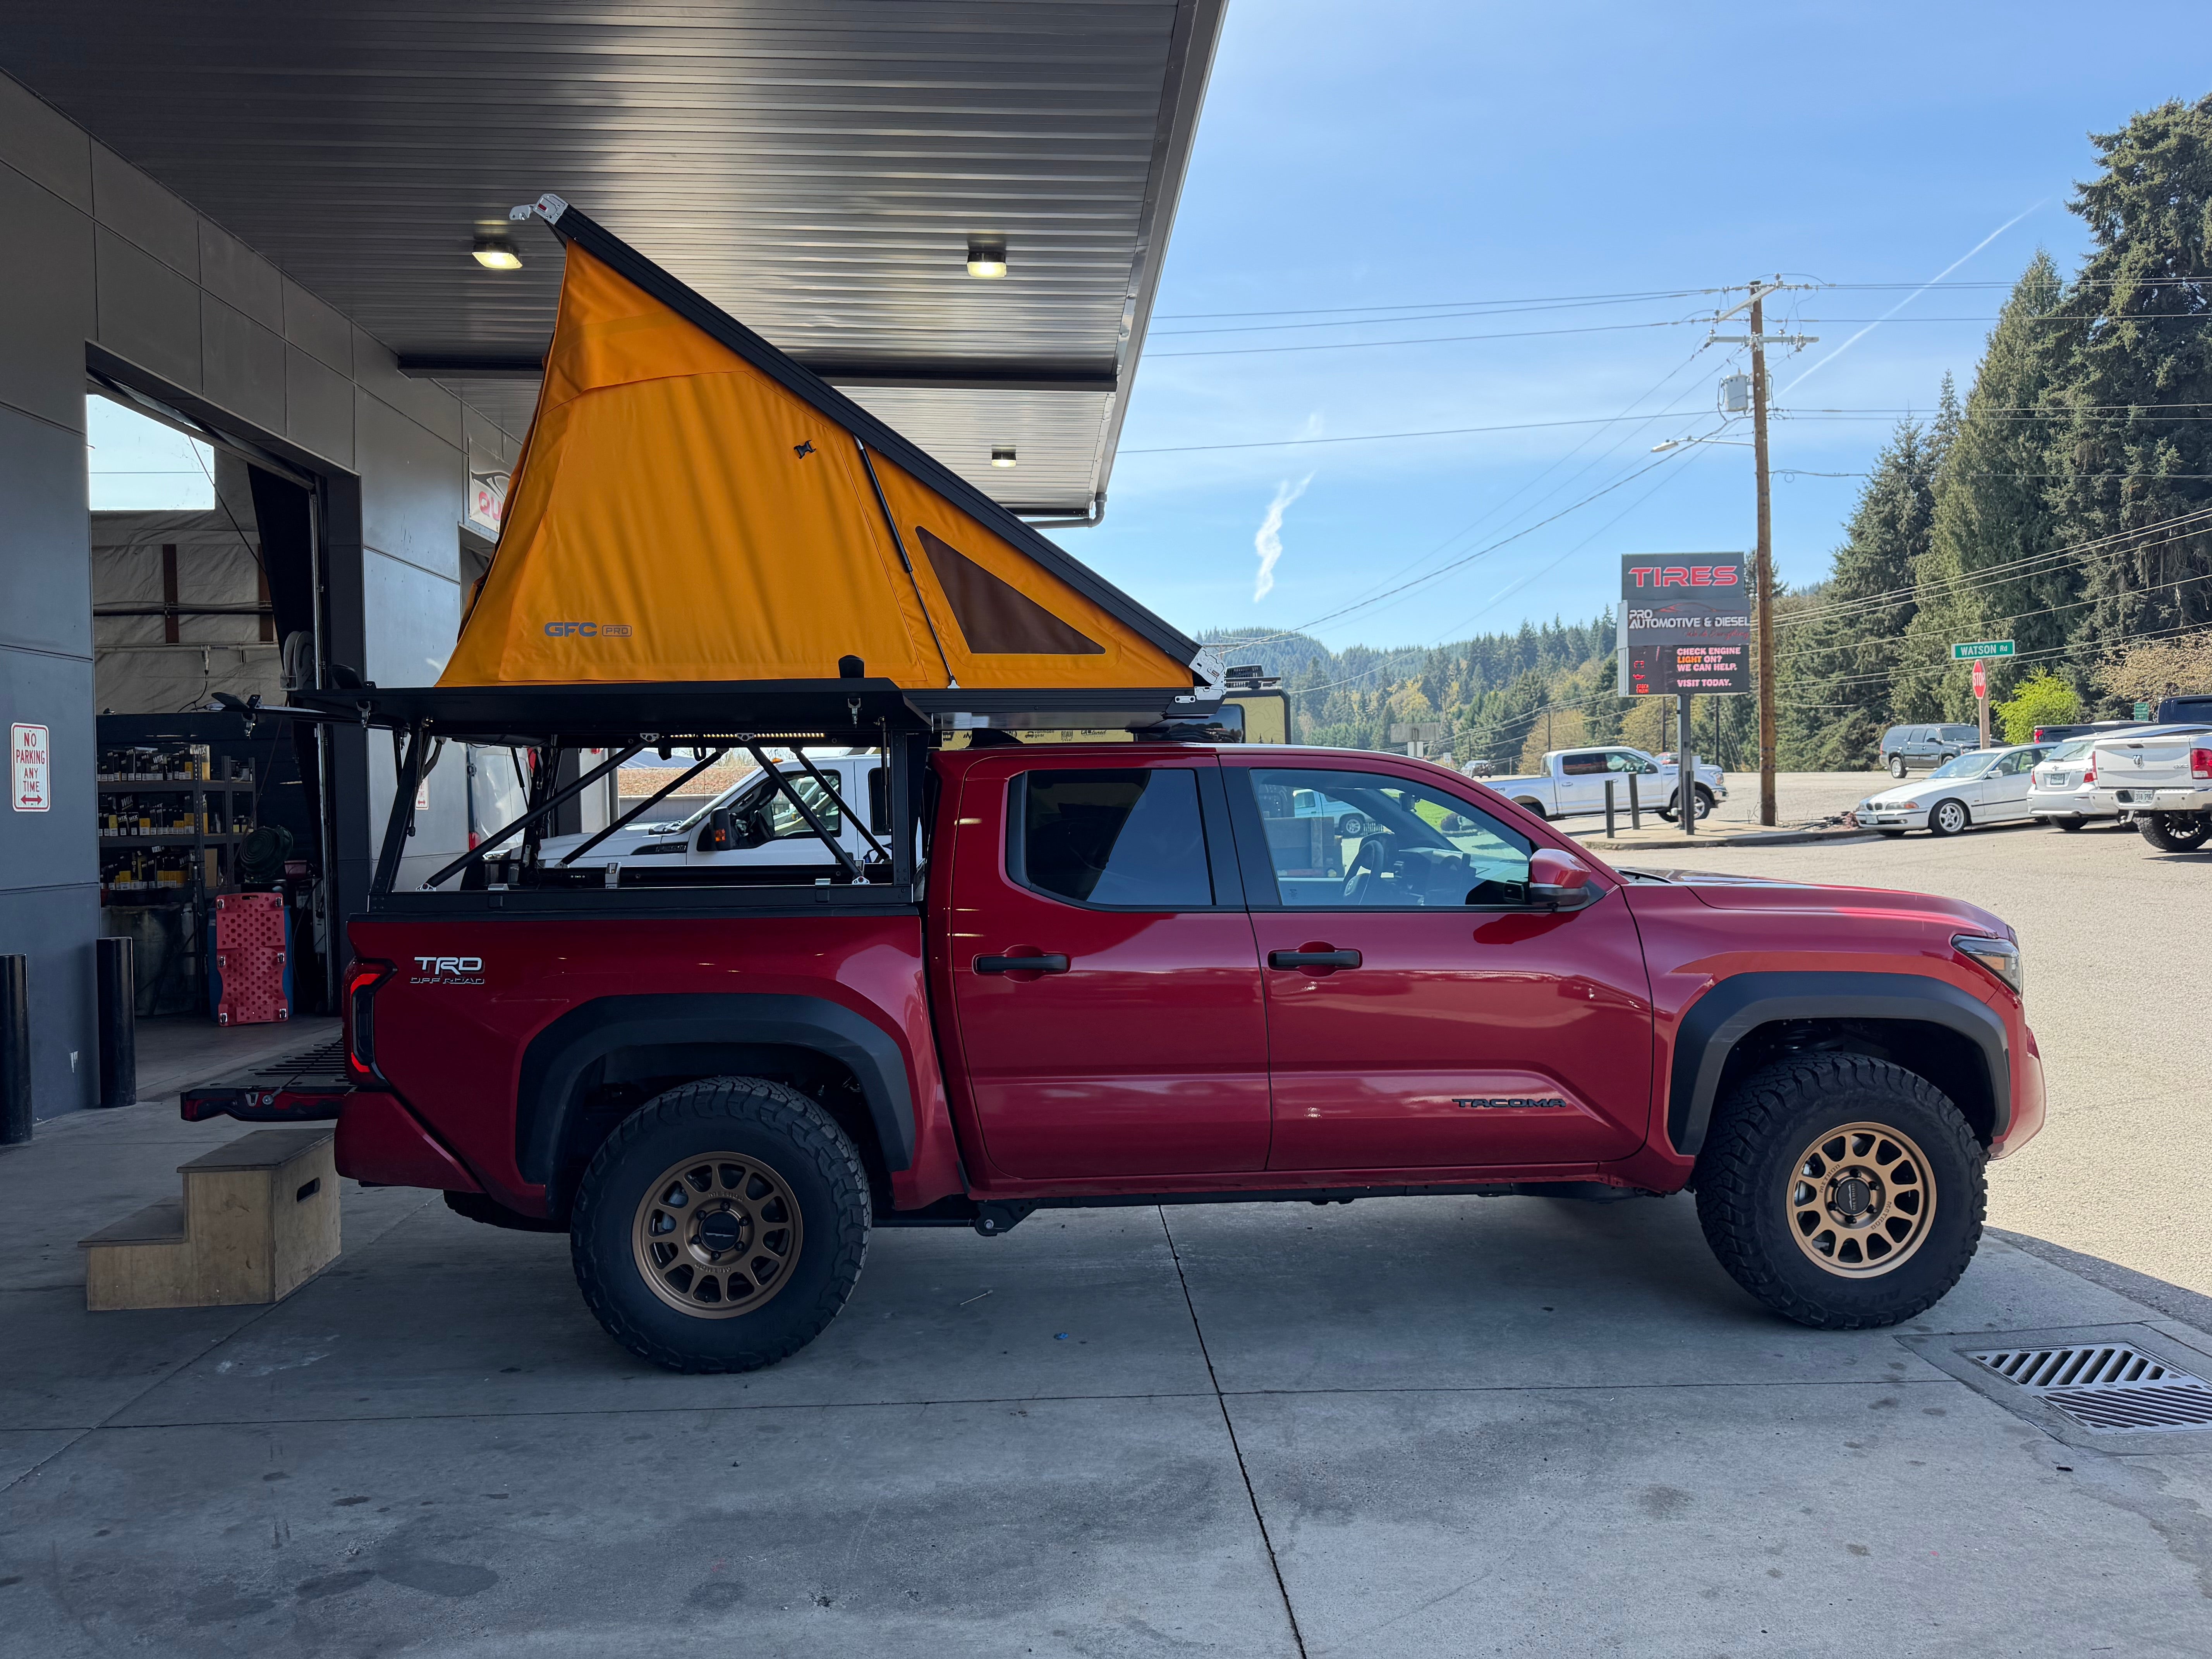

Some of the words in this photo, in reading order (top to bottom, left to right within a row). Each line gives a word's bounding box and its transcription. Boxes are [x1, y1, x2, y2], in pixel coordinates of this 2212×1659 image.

[479, 491, 503, 521] QU
[1628, 566, 1738, 587] TIRES
[1629, 609, 1652, 619] PRO
[1629, 617, 1700, 629] AUTOMOTIVE
[1704, 617, 1712, 627] &
[1715, 616, 1750, 627] DIESEL
[544, 622, 597, 637] GFC
[1677, 647, 1707, 656] CHECK
[1708, 647, 1741, 655] ENGINE
[1961, 644, 1996, 656] WATSON
[1677, 664, 1692, 672] WE
[1677, 679, 1700, 687] VISIT
[1701, 678, 1732, 687] TODAY.
[1973, 672, 1985, 687] STOP
[24, 733, 37, 747] NO
[16, 749, 45, 764] PARKING
[153, 754, 163, 764] WIX
[24, 768, 38, 779] ANY
[23, 780, 40, 792] TIME
[121, 794, 133, 807] WIX
[414, 957, 482, 975] TRD
[1452, 1099, 1566, 1108] TACOMA
[1819, 1164, 1840, 1193] METHOD
